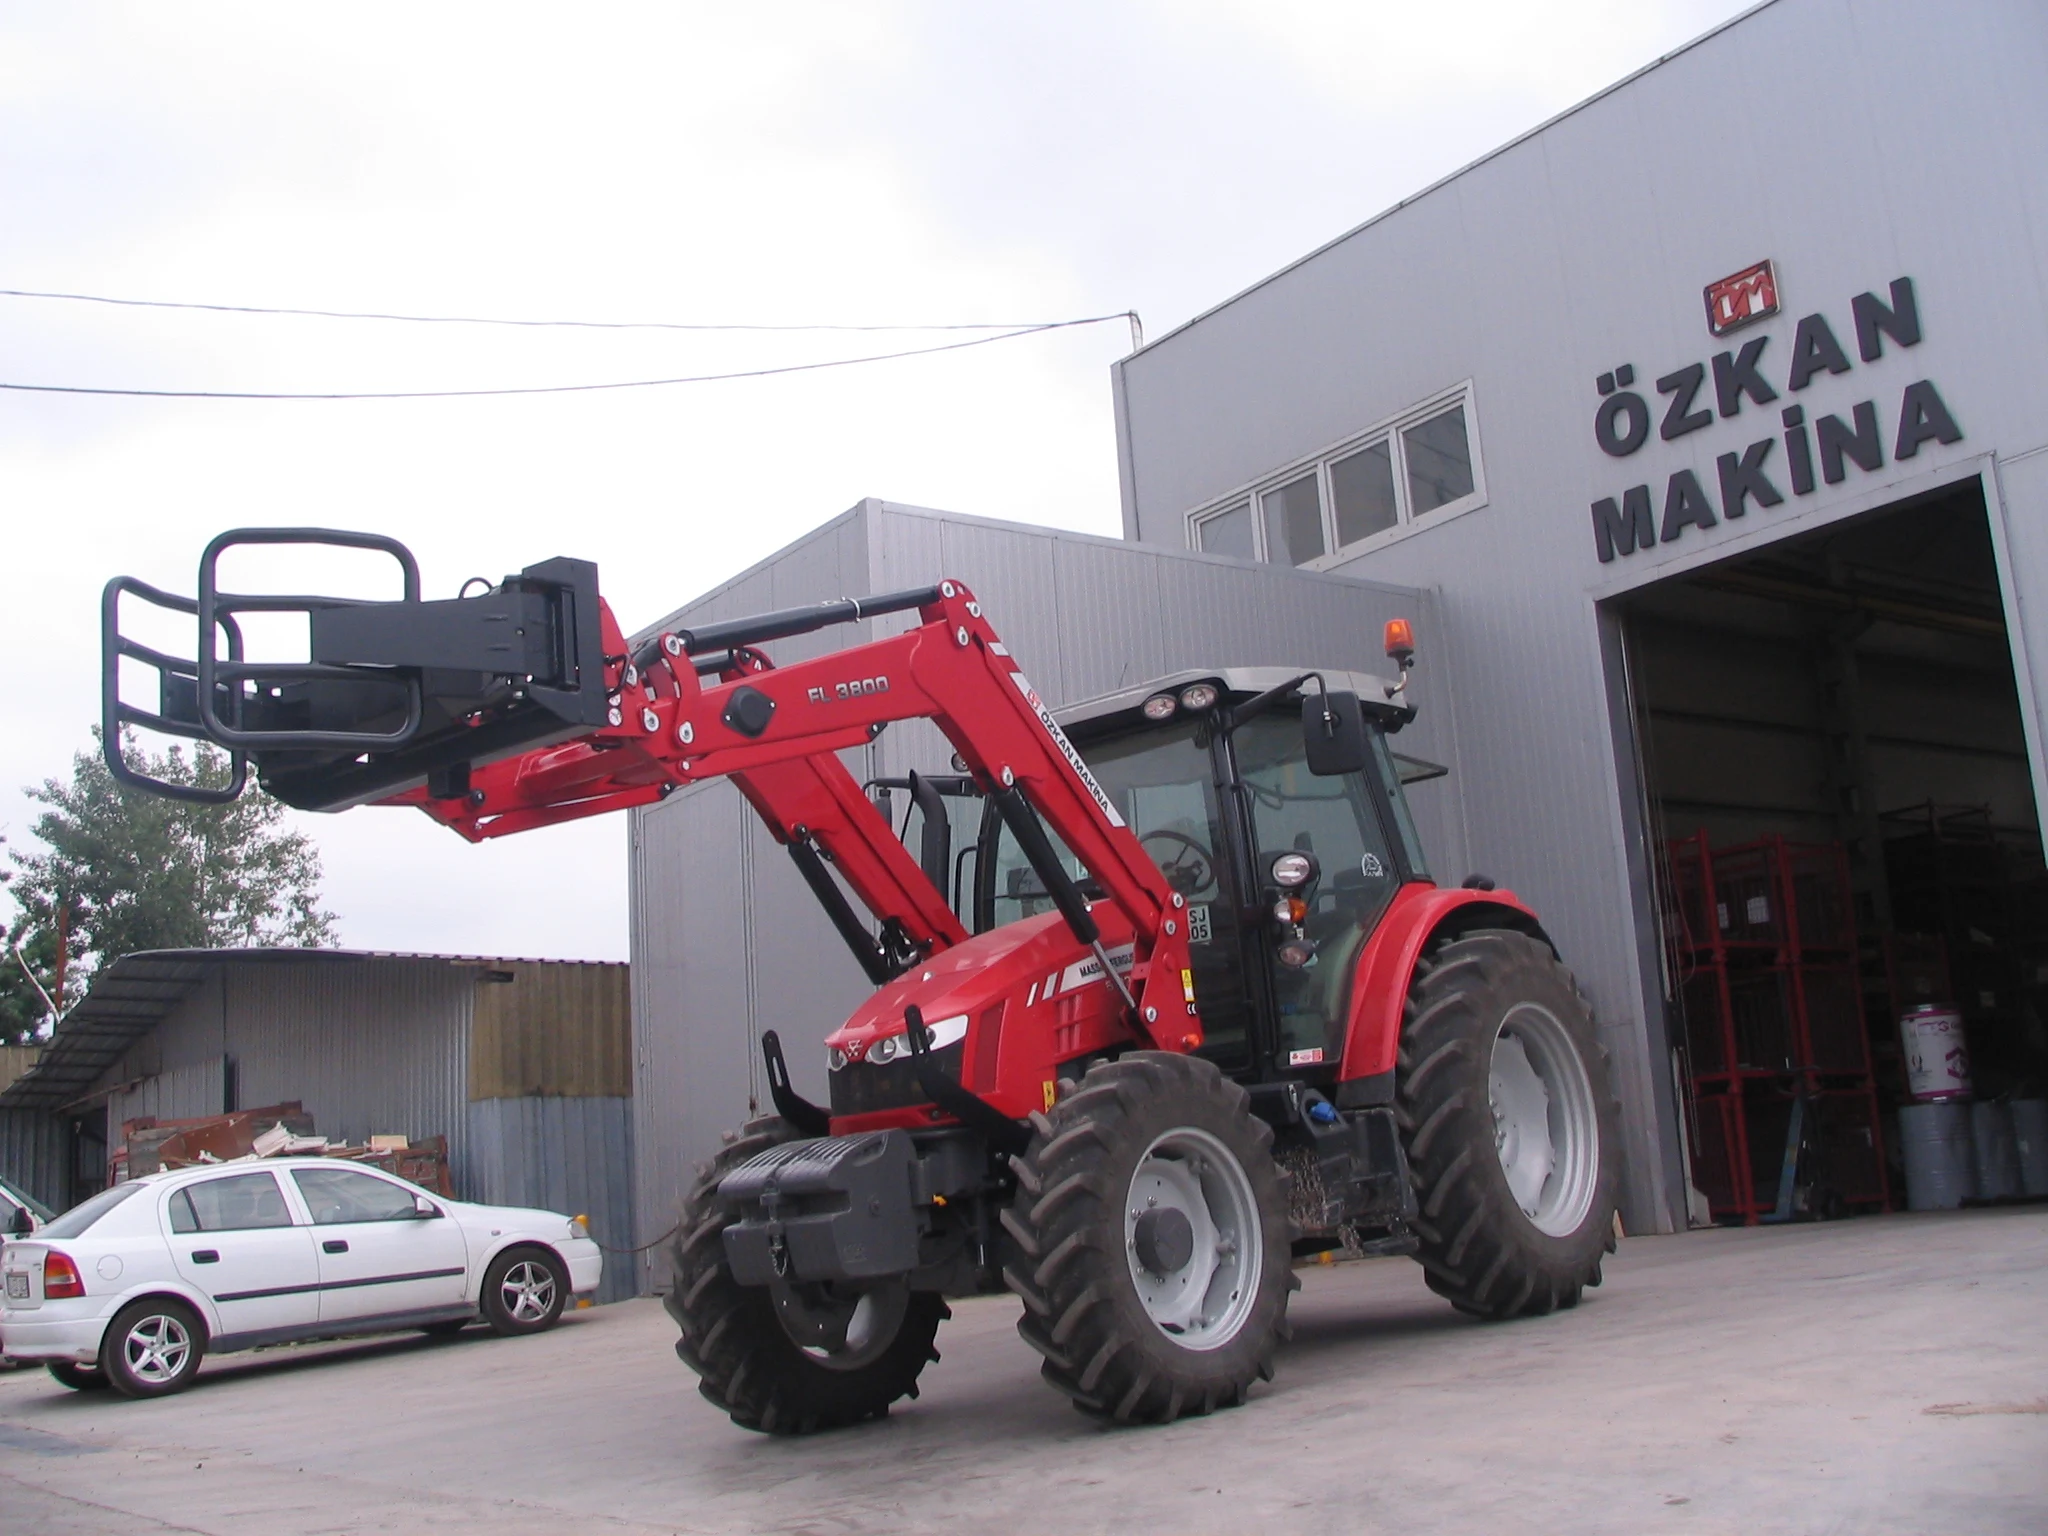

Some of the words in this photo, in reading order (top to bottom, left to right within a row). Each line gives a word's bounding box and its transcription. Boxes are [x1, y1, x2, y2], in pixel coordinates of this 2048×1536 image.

[1594, 276, 1922, 458] ÖZKAN
[1590, 379, 1964, 564] MAKİNA
[807, 686, 832, 704] FL
[835, 675, 889, 700] 3800
[1041, 710, 1074, 760] ÖZKAN
[1073, 758, 1109, 812] MAKİNA
[1189, 908, 1206, 924] SJ
[1191, 924, 1208, 940] 05
